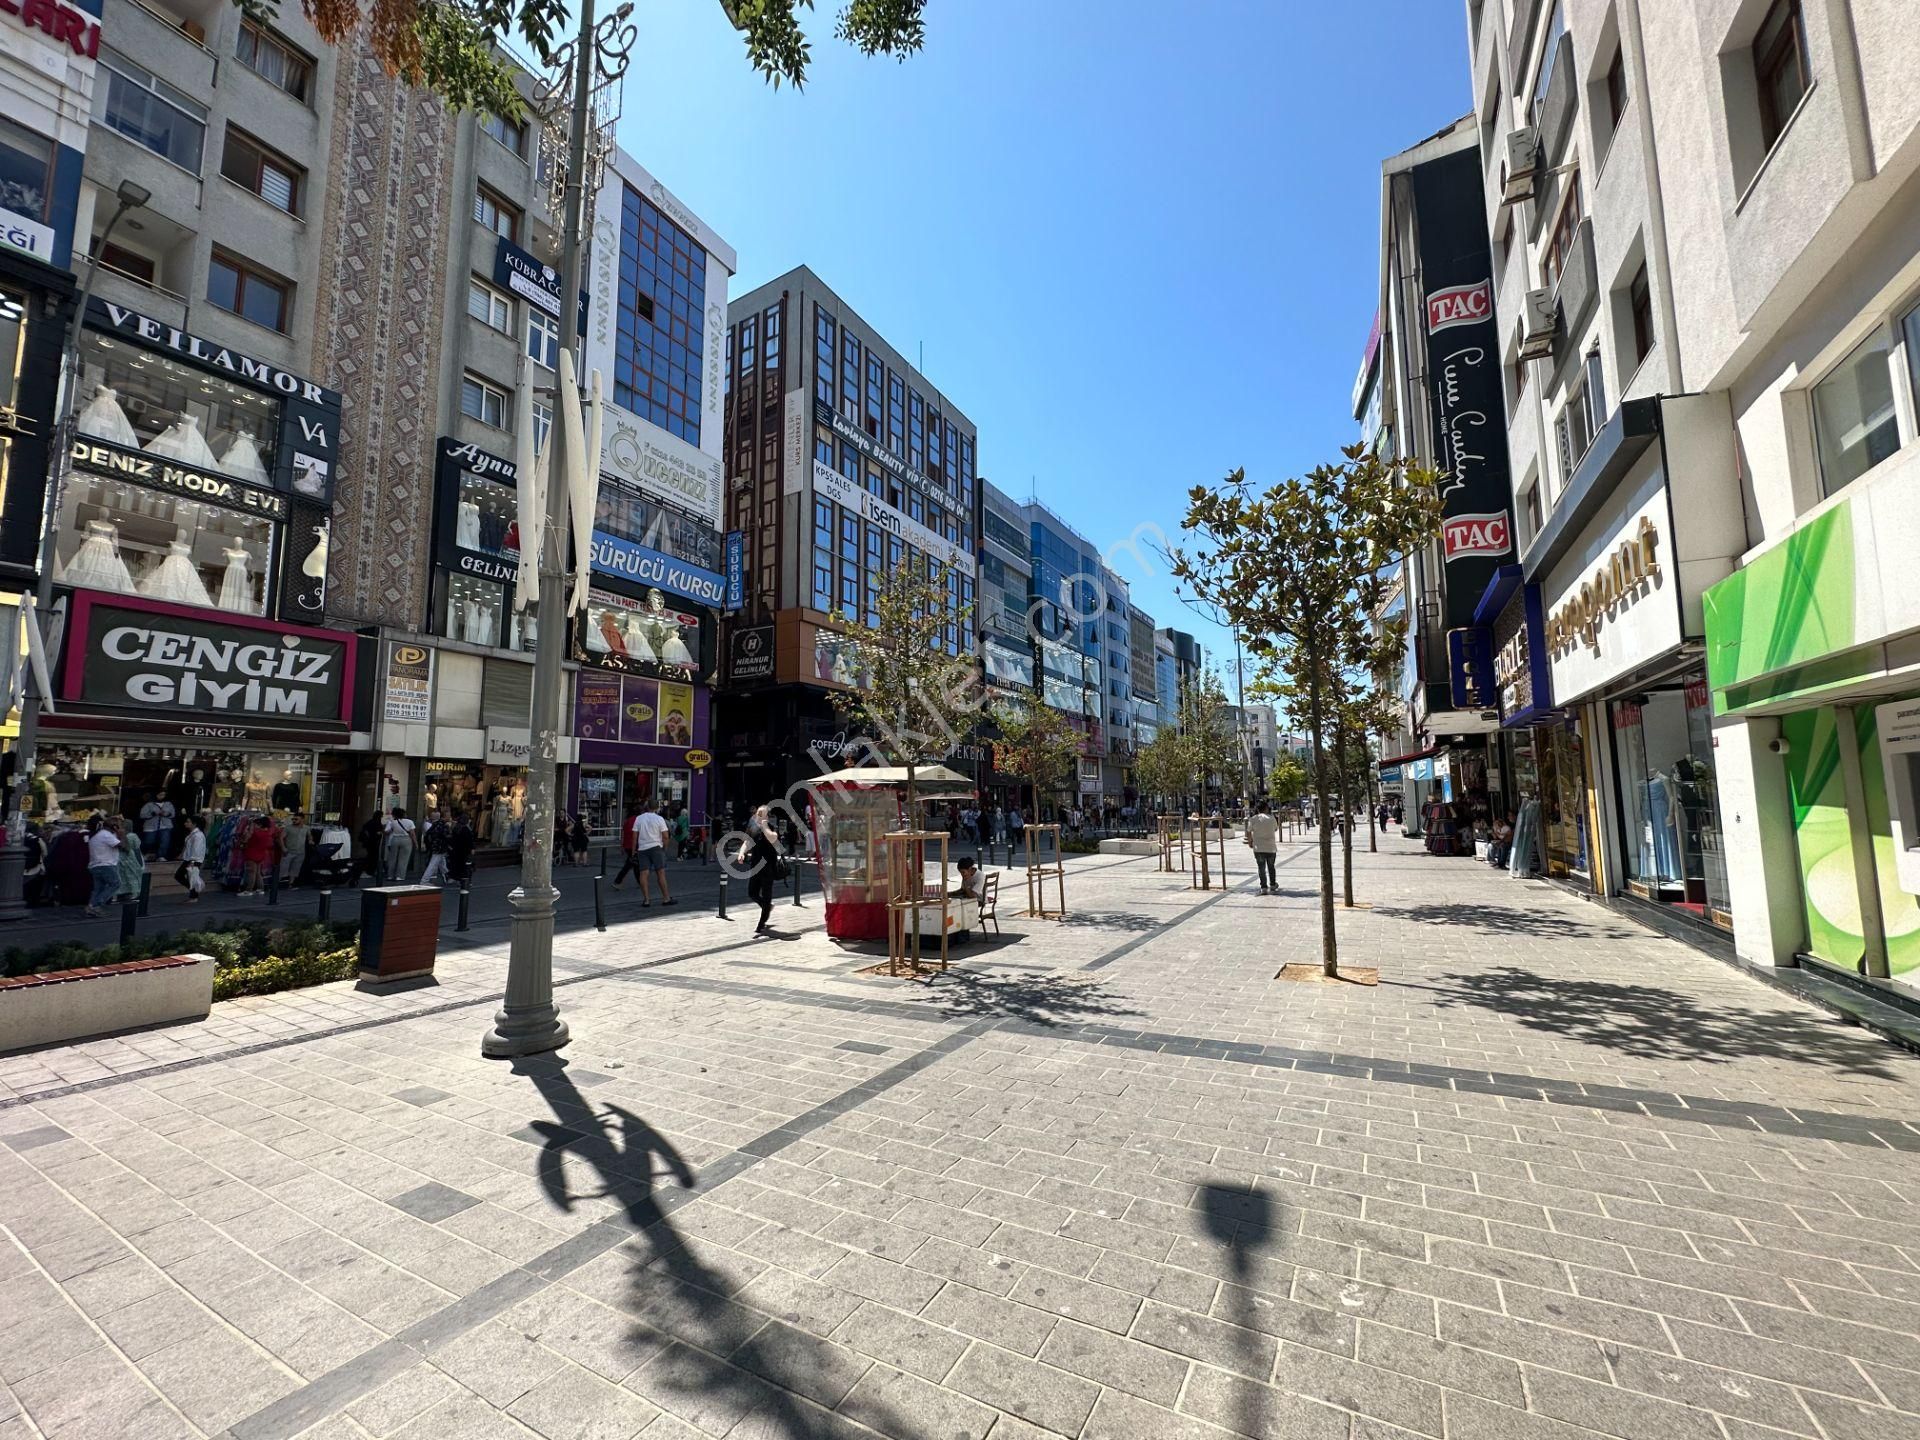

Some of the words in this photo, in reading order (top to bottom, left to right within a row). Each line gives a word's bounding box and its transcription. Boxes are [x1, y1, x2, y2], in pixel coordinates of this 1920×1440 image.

[505, 252, 546, 287] KÜBRA
[1431, 288, 1488, 324] TAÇ
[103, 301, 324, 405] VEILAMOR
[1443, 347, 1484, 408] Pierre
[298, 415, 328, 448] VA
[446, 443, 518, 481] Aynu
[873, 445, 904, 475] BEAUTY
[1443, 411, 1486, 499] Cardin
[163, 467, 234, 498] MODA
[815, 463, 835, 483] KPSS
[826, 484, 842, 500] DGS
[870, 499, 901, 534] isem
[902, 524, 944, 558] akademi
[1448, 519, 1506, 553] TAÇ
[461, 556, 519, 582] GELİNL
[590, 540, 665, 582] SÜRÜCÜ
[667, 567, 723, 602] KURSU
[101, 626, 332, 685] CENGİZ
[125, 672, 309, 716] GİYİM
[182, 726, 247, 739] CENGİZ
[490, 738, 532, 753] Lizge
[425, 761, 466, 772] NDİRİM
[688, 751, 711, 762] gratis
